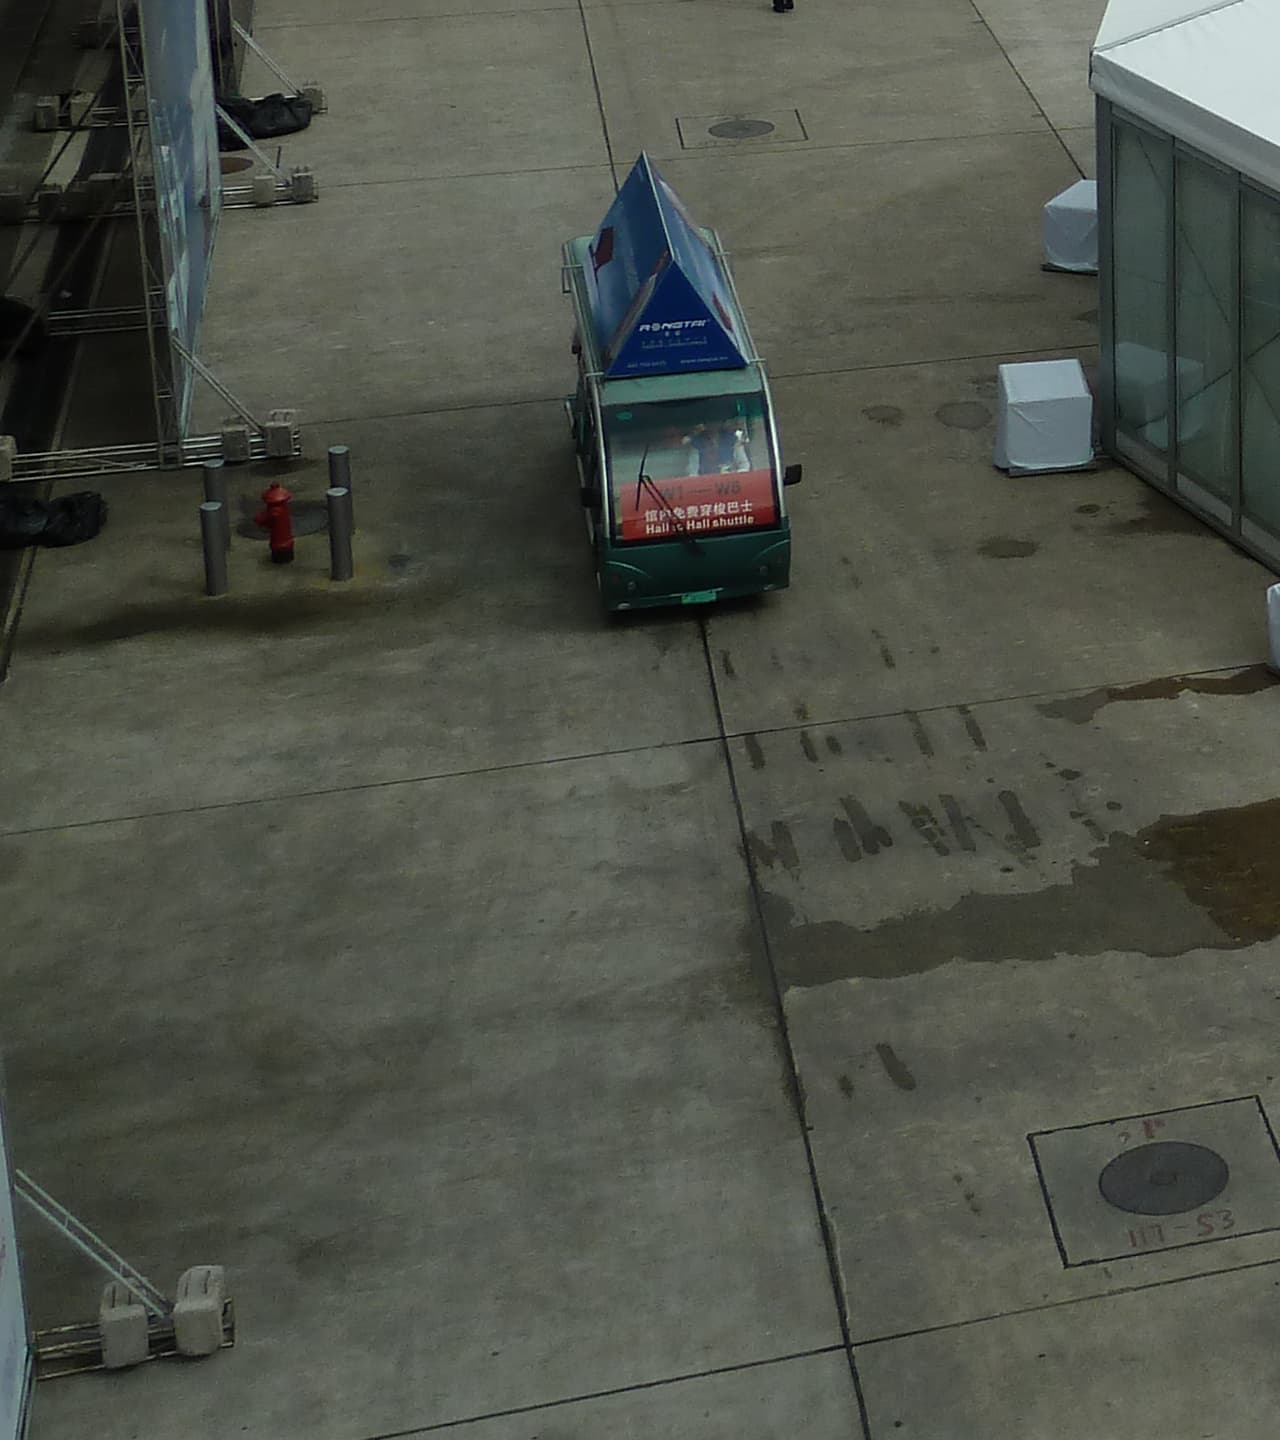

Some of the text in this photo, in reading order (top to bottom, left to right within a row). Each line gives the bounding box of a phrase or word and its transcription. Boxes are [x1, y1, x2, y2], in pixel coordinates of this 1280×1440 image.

[645, 522, 670, 535] Hall
[686, 518, 710, 531] Hall
[712, 514, 754, 527] shuttle
